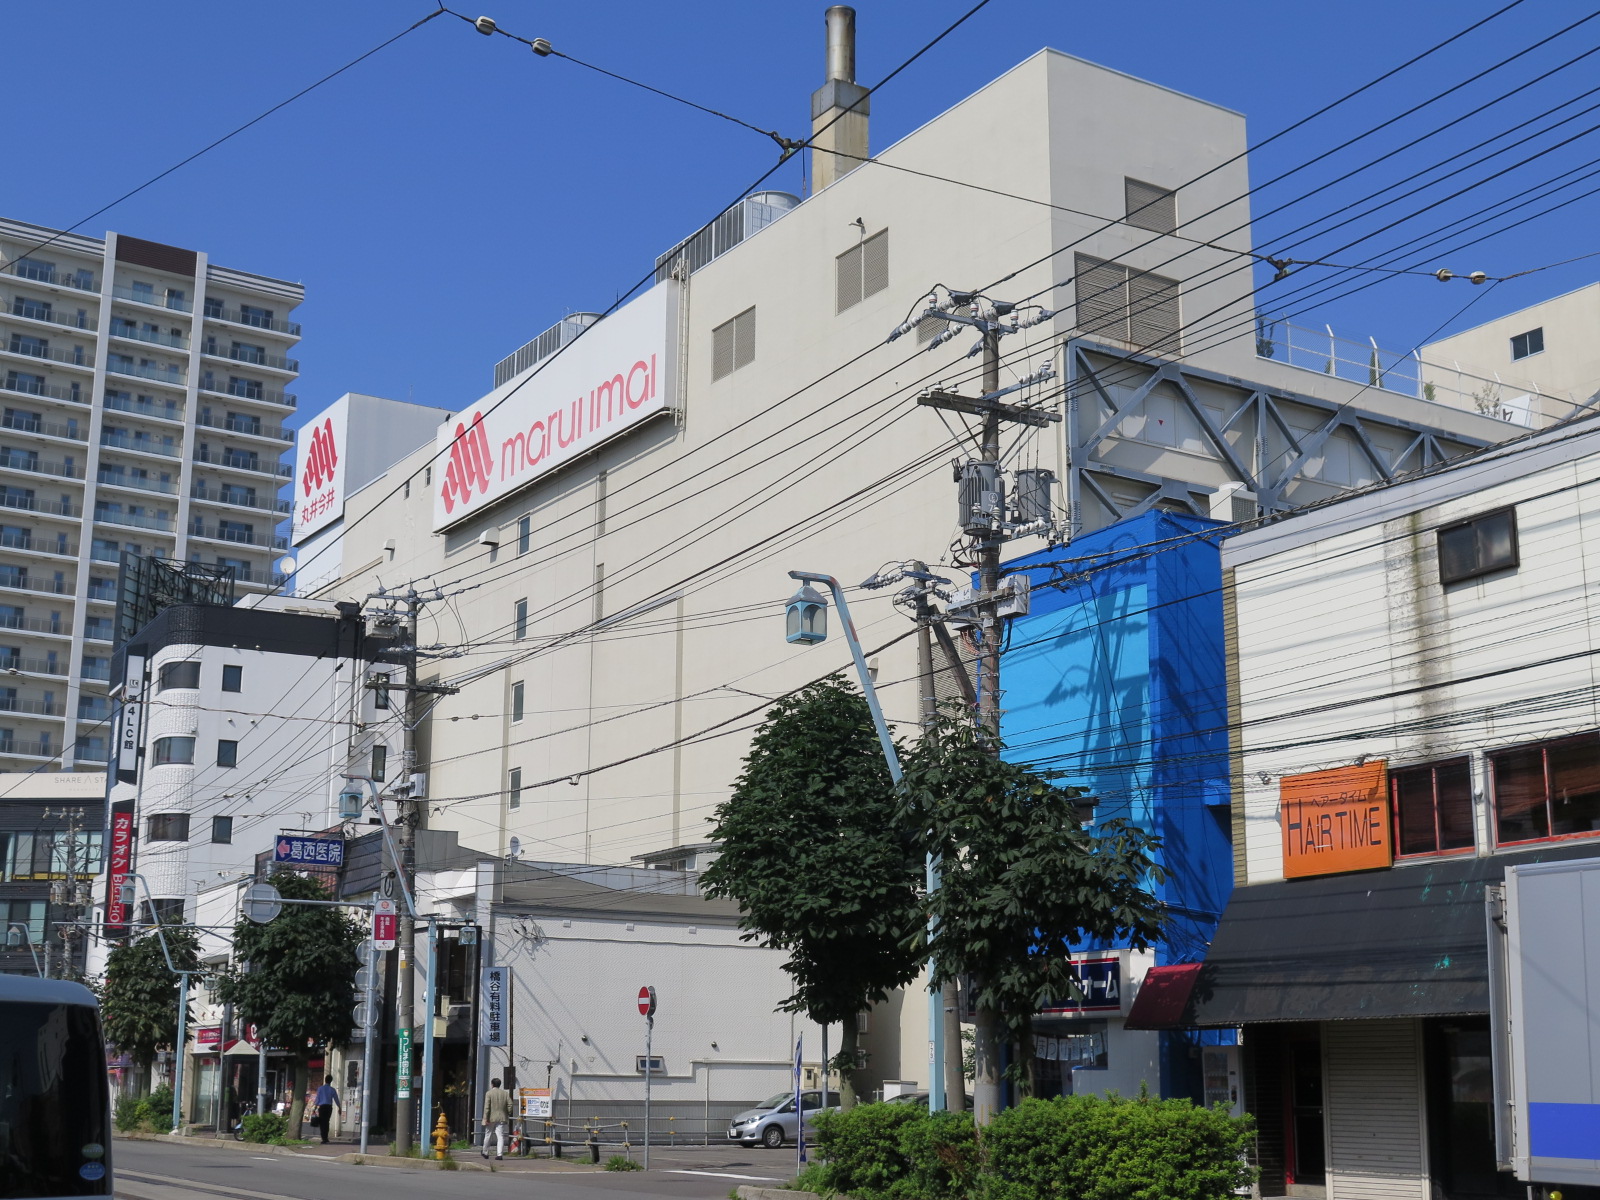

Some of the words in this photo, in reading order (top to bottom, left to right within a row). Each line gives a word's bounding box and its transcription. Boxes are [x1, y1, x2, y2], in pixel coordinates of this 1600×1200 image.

[301, 486, 335, 527] 丸井今井
[54, 776, 82, 784] SHARE
[1311, 790, 1367, 807] ヘアータイム
[112, 818, 129, 868] カラオケ
[291, 841, 341, 862] 葛西医院
[489, 971, 501, 1042] 橋谷有料駐車場
